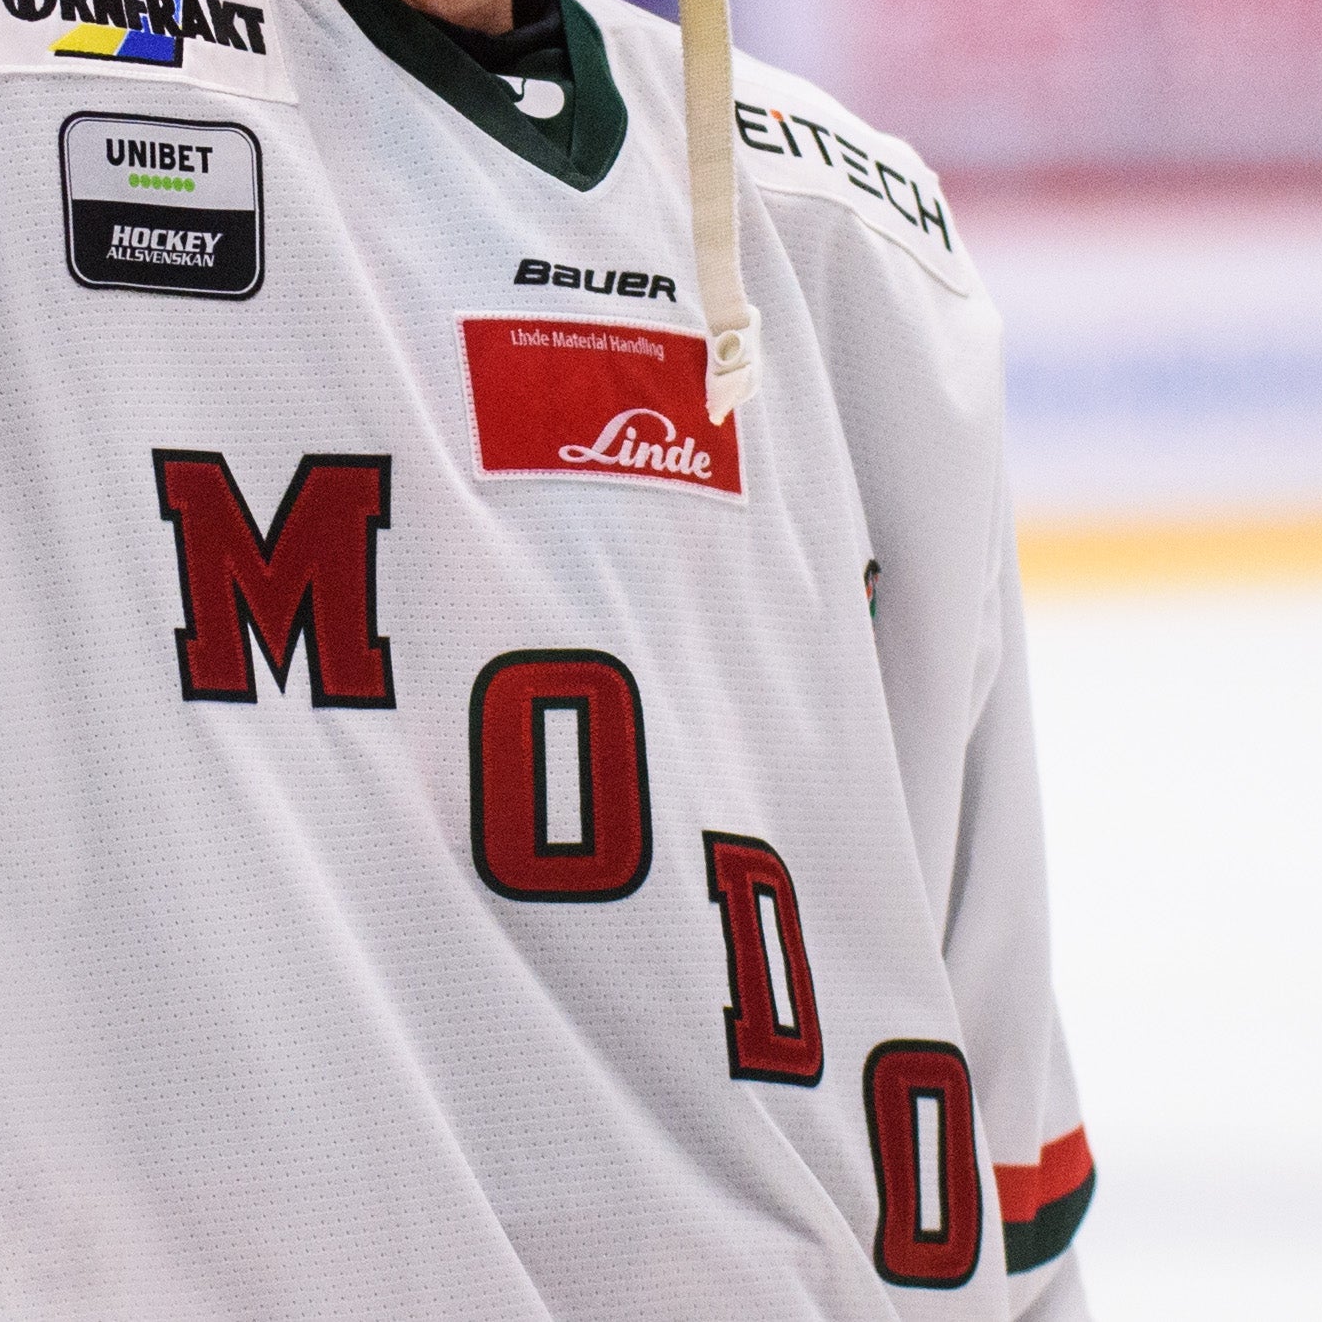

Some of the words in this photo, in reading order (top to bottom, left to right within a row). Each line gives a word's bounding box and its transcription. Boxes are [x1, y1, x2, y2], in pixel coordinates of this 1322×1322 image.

[106, 138, 213, 174] UNIBET
[106, 247, 215, 268] ALLSVENSKAN
[111, 224, 223, 255] HOCKEY
[513, 258, 677, 303] BAUER
[510, 327, 550, 347] Linde
[552, 331, 608, 351] Material
[609, 334, 665, 362] Handling
[558, 407, 713, 480] Linde
[152, 447, 983, 1291] MODO
